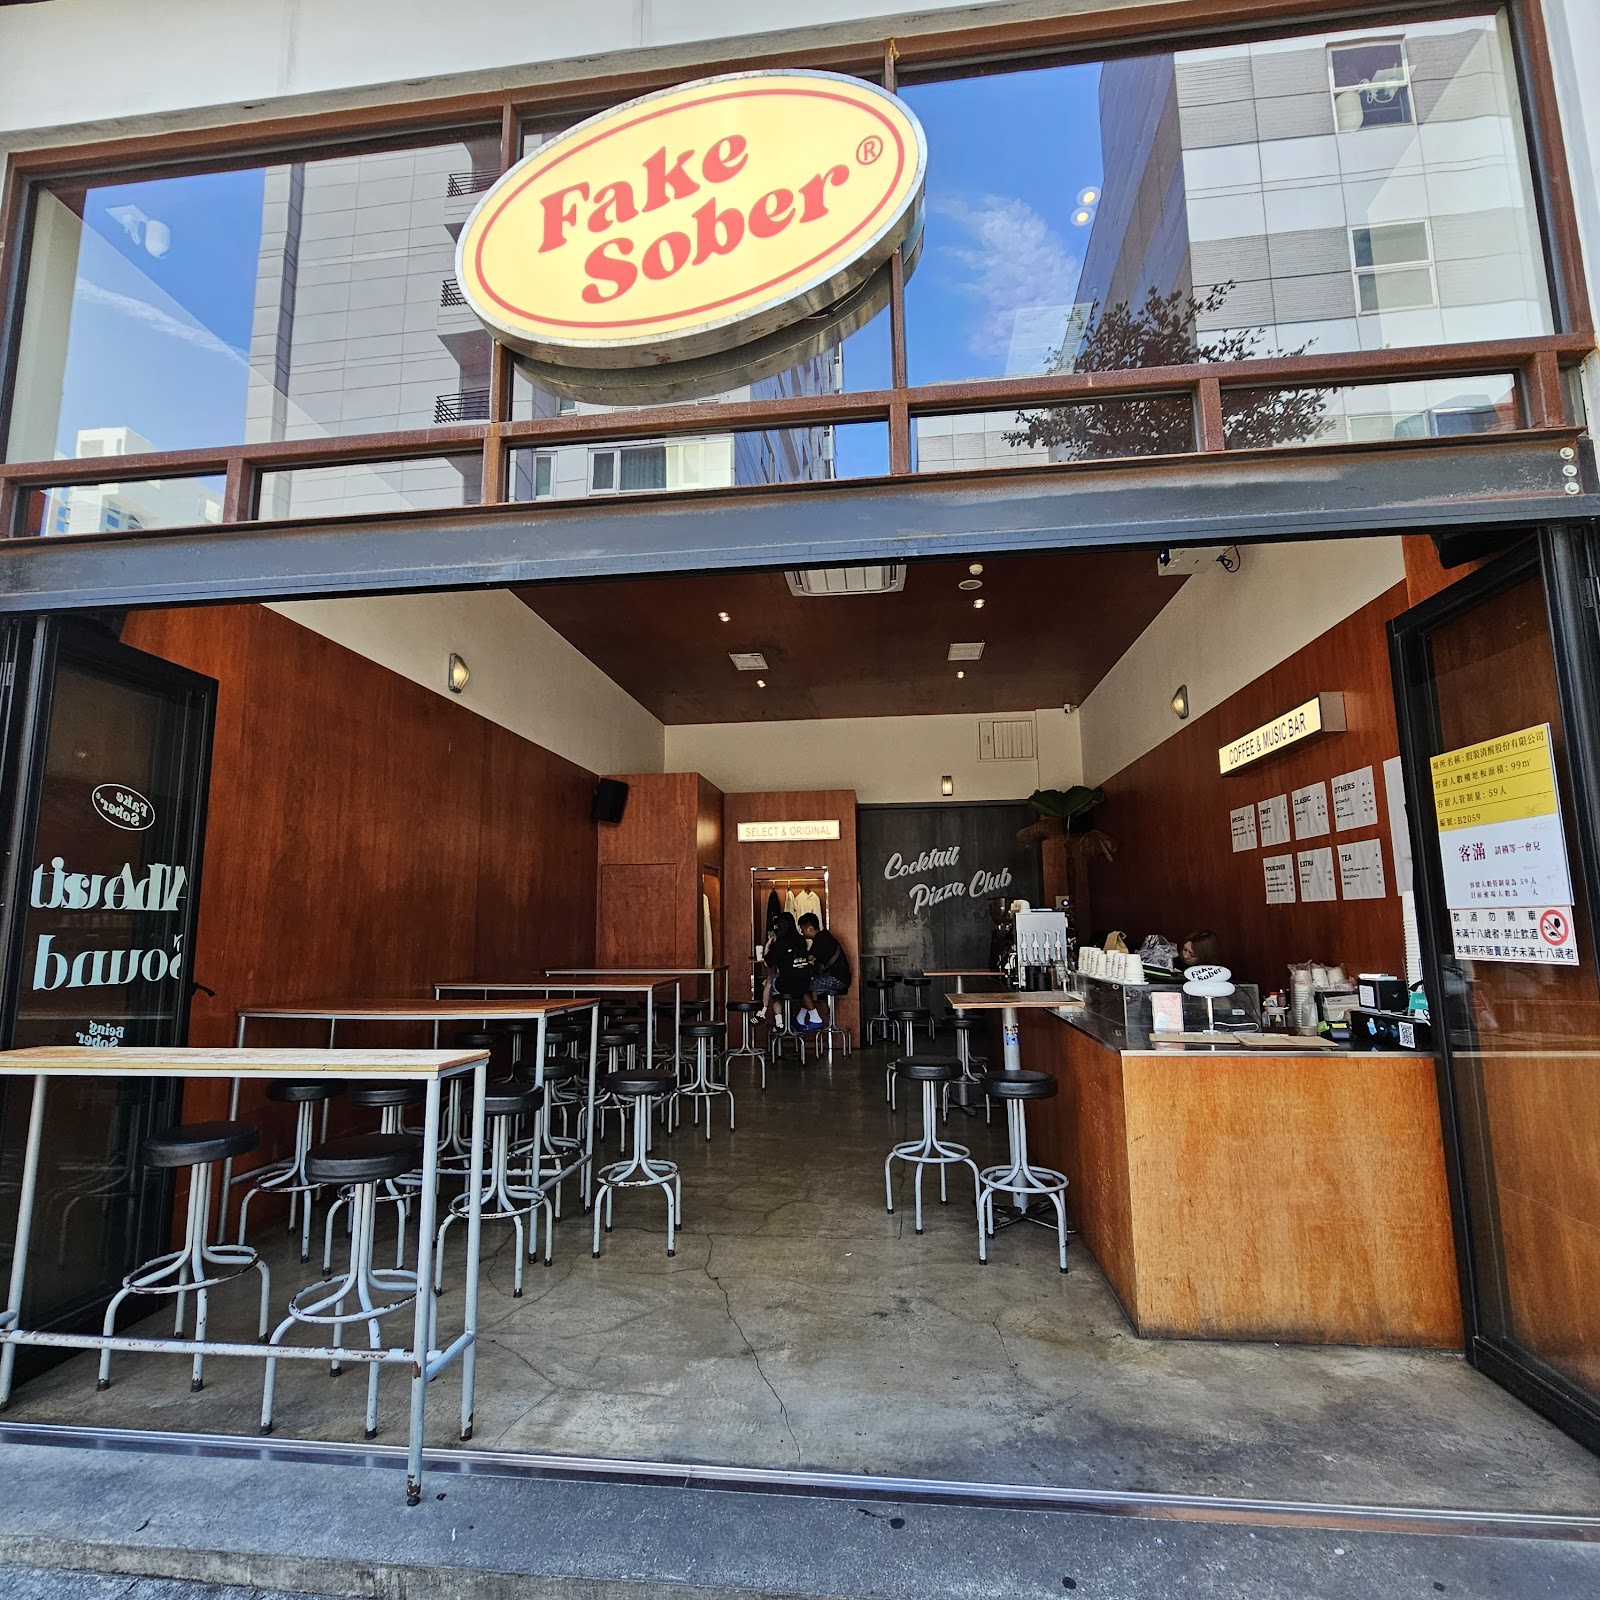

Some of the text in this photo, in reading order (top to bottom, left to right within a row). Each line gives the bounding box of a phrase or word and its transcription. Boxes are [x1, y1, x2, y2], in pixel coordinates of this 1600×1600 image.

[538, 134, 749, 253] Fake
[581, 164, 850, 304] Sober
[1229, 712, 1307, 765] COFFEE & MUSIC BAR
[1334, 782, 1355, 794] OTHERS
[1294, 795, 1311, 806] CLASSIC
[745, 825, 831, 837] SELECT & ORIGINAL
[1341, 853, 1352, 862] TEA
[1458, 842, 1486, 862] 客滿
[884, 846, 960, 880] Cocktail
[909, 867, 1012, 915] Pizza Club
[1197, 968, 1222, 981] Sober
